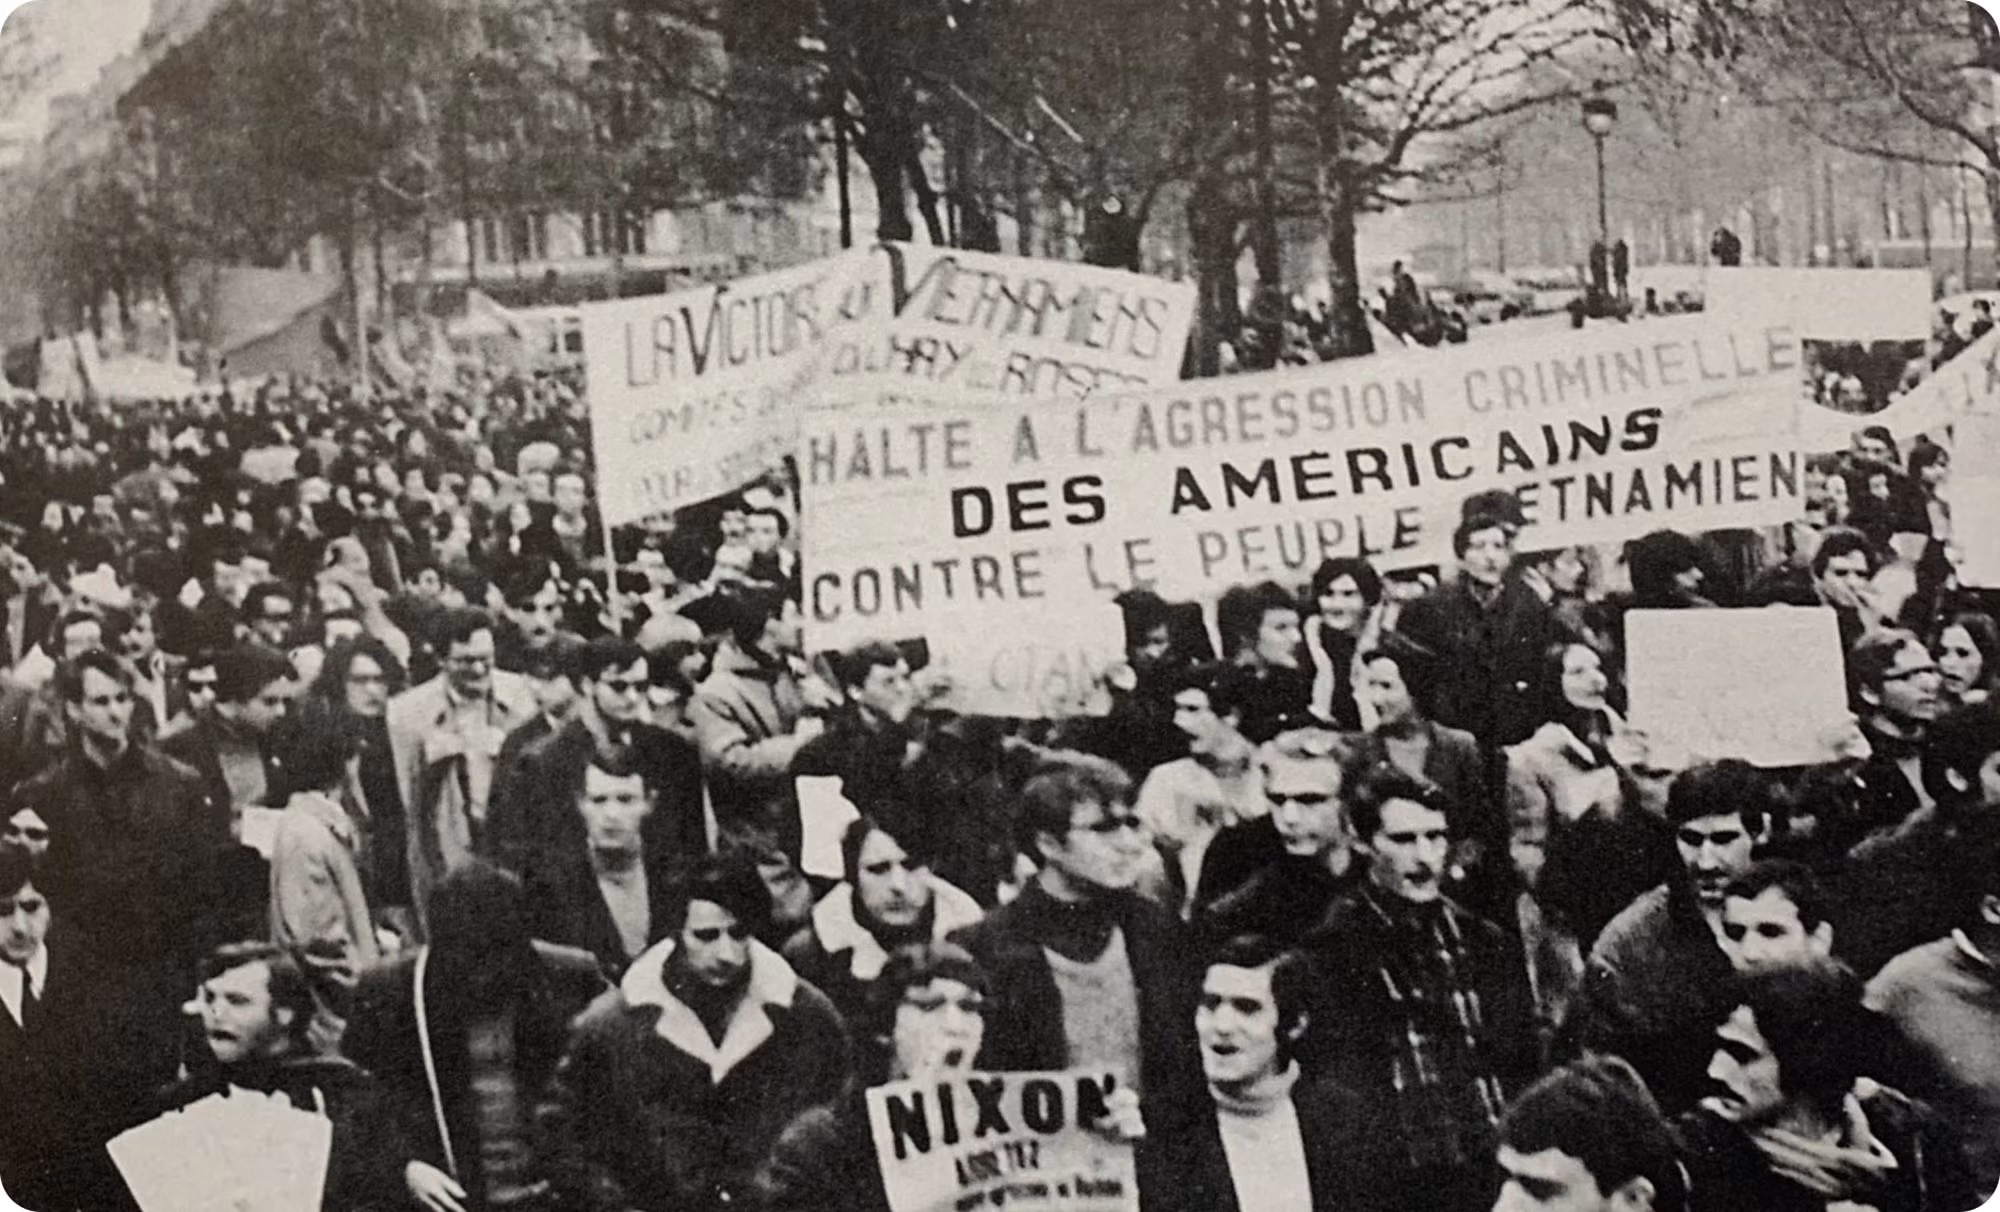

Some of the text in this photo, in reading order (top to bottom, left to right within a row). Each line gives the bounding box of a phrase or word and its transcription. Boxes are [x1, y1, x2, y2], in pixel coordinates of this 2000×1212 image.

[808, 420, 973, 486] HALTE
[1012, 414, 1041, 463] A
[1465, 325, 1796, 415] CRIMINELLE
[811, 450, 1800, 623] CONTRE LE PEUPLE ETNAMIEN
[950, 474, 1108, 539] DES
[885, 1072, 1117, 1162] NIXON
